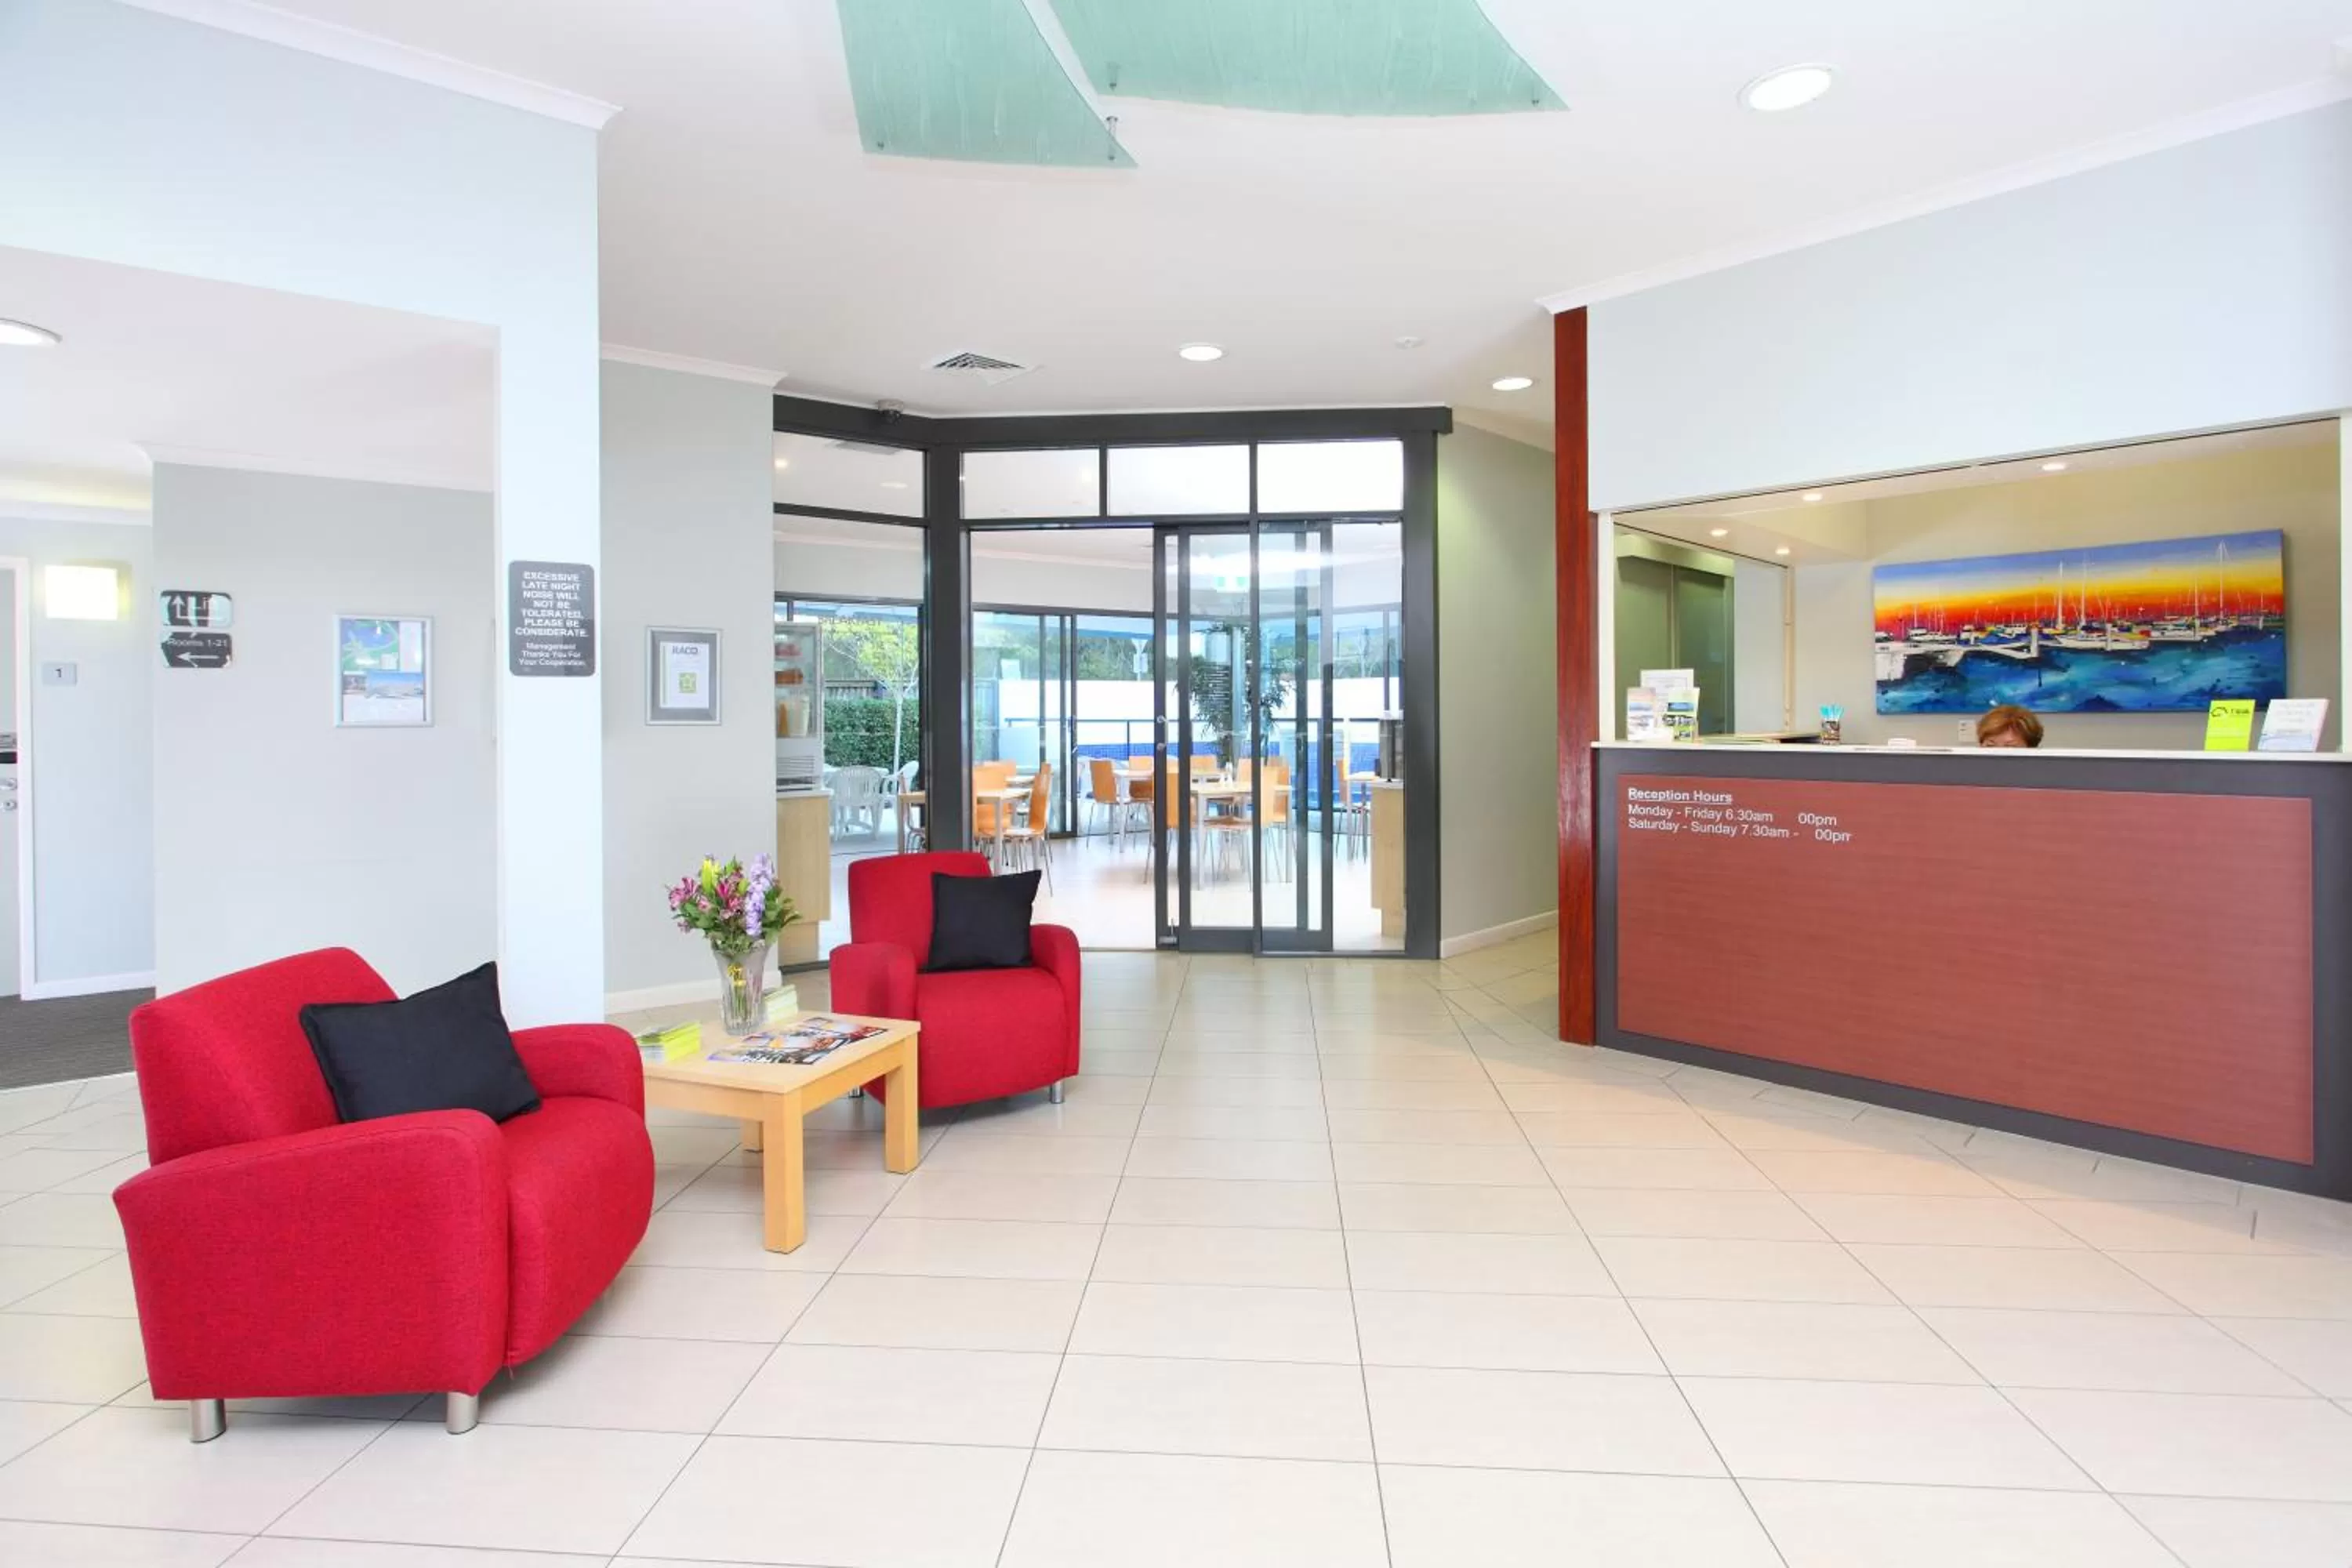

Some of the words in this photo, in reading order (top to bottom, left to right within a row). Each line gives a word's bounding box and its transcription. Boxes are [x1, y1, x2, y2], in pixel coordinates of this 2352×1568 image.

[524, 572, 580, 581] EXCESSIVE
[522, 580, 548, 589] LATE
[550, 582, 580, 590] NIGHT
[523, 590, 553, 599] NOISE
[533, 600, 554, 608] NOT
[557, 601, 571, 609] BE
[524, 618, 564, 626] PLEASE
[566, 619, 580, 628] BE
[55, 668, 63, 678] 1
[1628, 787, 1690, 801] Reception
[1693, 790, 1732, 804] Hours
[1628, 804, 1674, 818] Monday
[1685, 807, 1722, 822] Friday
[1628, 817, 1679, 833] Saturday
[1691, 821, 1738, 837] Sunday
